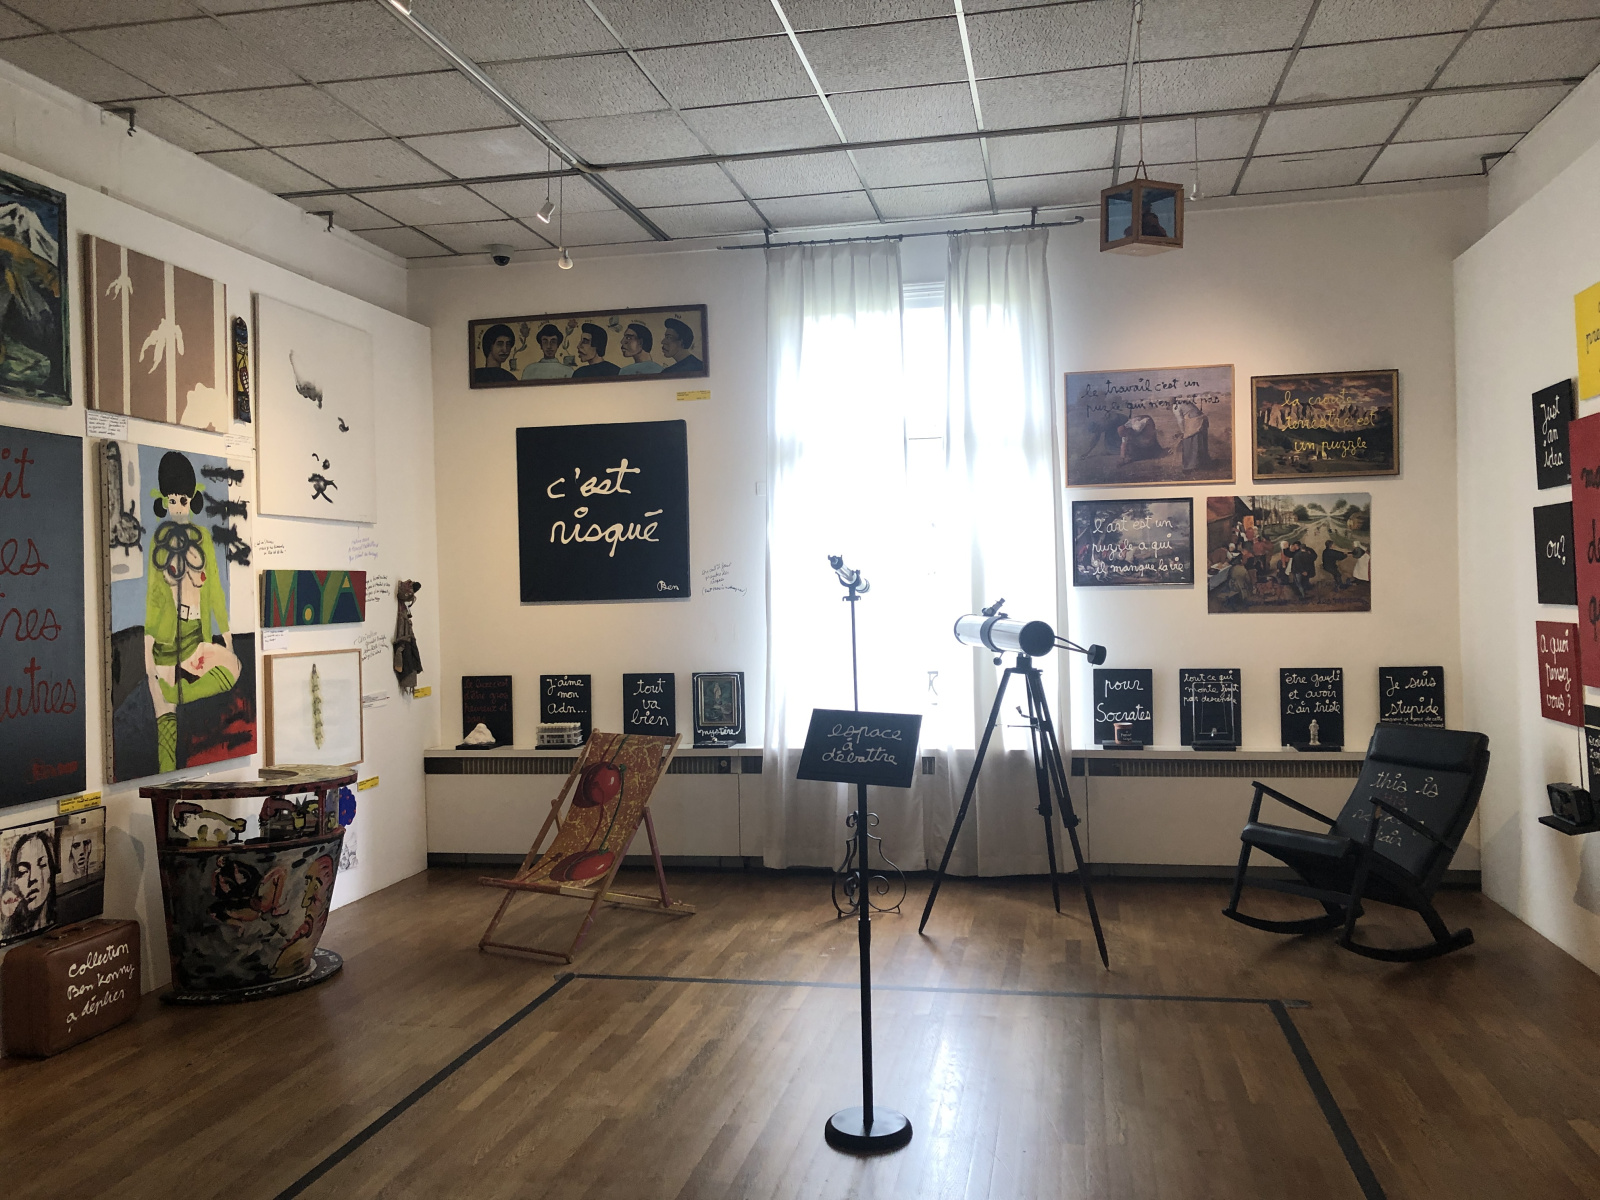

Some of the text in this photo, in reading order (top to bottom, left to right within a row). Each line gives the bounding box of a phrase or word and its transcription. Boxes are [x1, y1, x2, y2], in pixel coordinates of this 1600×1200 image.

[1081, 377, 1200, 398] le travail c'est un
[1127, 398, 1146, 418] qui
[1200, 395, 1220, 411] pas
[1281, 390, 1300, 407] la
[1281, 408, 1376, 431] terrestre est
[1547, 428, 1559, 443] an
[1294, 436, 1368, 458] un puzzle
[1543, 440, 1564, 468] idea
[547, 458, 640, 498] c'est
[550, 506, 663, 557] risqué
[1093, 515, 1173, 534] l'art est un
[1091, 538, 1133, 561] puzzle
[1151, 533, 1173, 558] qui
[1092, 557, 1184, 577] il manque la vie
[656, 580, 680, 591] Ben
[1550, 629, 1569, 665] quoi
[633, 678, 666, 695] tout
[1184, 673, 1206, 682] tout
[1219, 669, 1233, 685] qui
[1284, 673, 1307, 684] être
[1405, 670, 1437, 689] suis
[1545, 663, 1572, 692] pensez
[0, 656, 77, 718] utres
[557, 691, 580, 699] mon
[1105, 679, 1144, 698] pour
[1289, 685, 1337, 700] et avoir
[642, 699, 661, 710] va
[1201, 694, 1237, 705] descende
[1286, 699, 1341, 715] l'air triste
[1385, 696, 1440, 720] stupide
[1546, 693, 1565, 712] vous
[630, 708, 669, 726] bien
[1096, 702, 1151, 722] Socrates
[827, 723, 902, 743] espace
[822, 747, 898, 765] débattre
[1370, 771, 1439, 798] this is
[68, 943, 129, 978] Collection
[66, 985, 94, 1000] Ben
